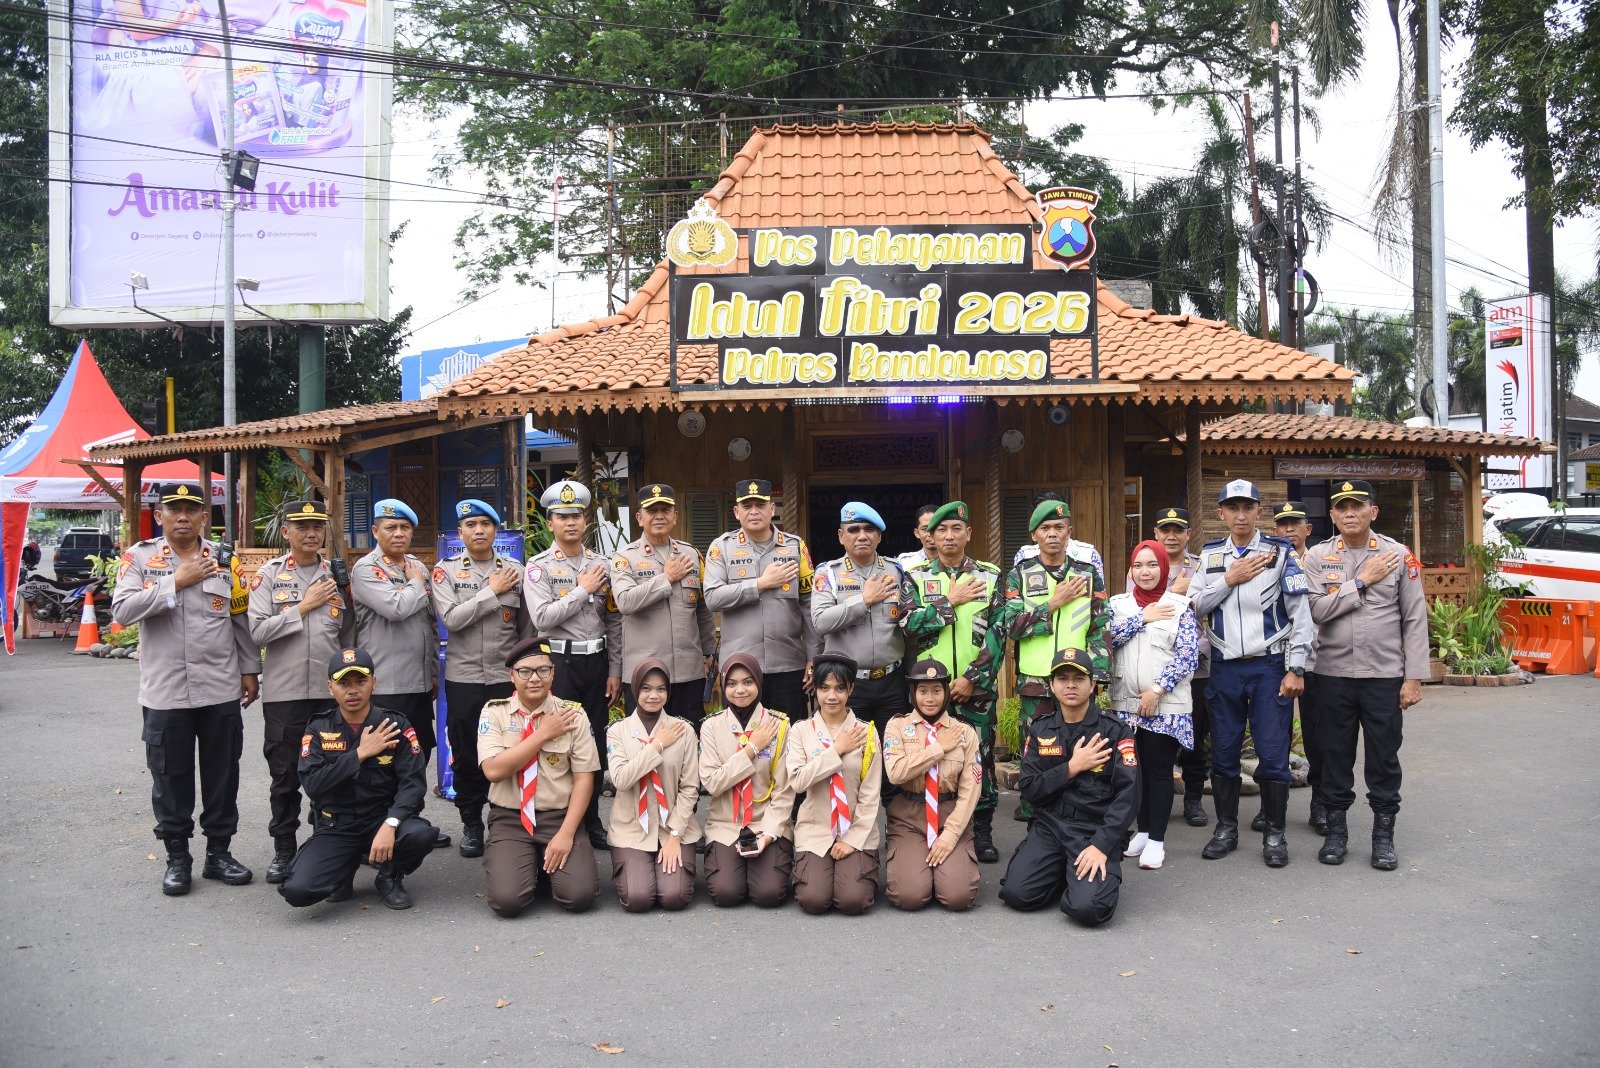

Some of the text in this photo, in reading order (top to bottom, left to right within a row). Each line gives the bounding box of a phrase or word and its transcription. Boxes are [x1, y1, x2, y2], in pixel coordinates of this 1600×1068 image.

[114, 51, 138, 60] RICIS
[151, 45, 189, 56] MOANA
[102, 57, 184, 71] Brand Ambassador
[281, 135, 306, 144] FREE
[107, 172, 221, 218] Aman
[265, 181, 340, 216] Kulit
[1043, 191, 1094, 202] JAWA TIMUR
[753, 226, 1027, 271] Pos Pelayanan
[687, 282, 804, 340] Idul
[955, 290, 1090, 335] 2026
[1489, 305, 1523, 322] atm
[723, 342, 1048, 386] Polres Bondowoso
[730, 558, 753, 566] ARYO
[1562, 614, 1570, 625] 21
